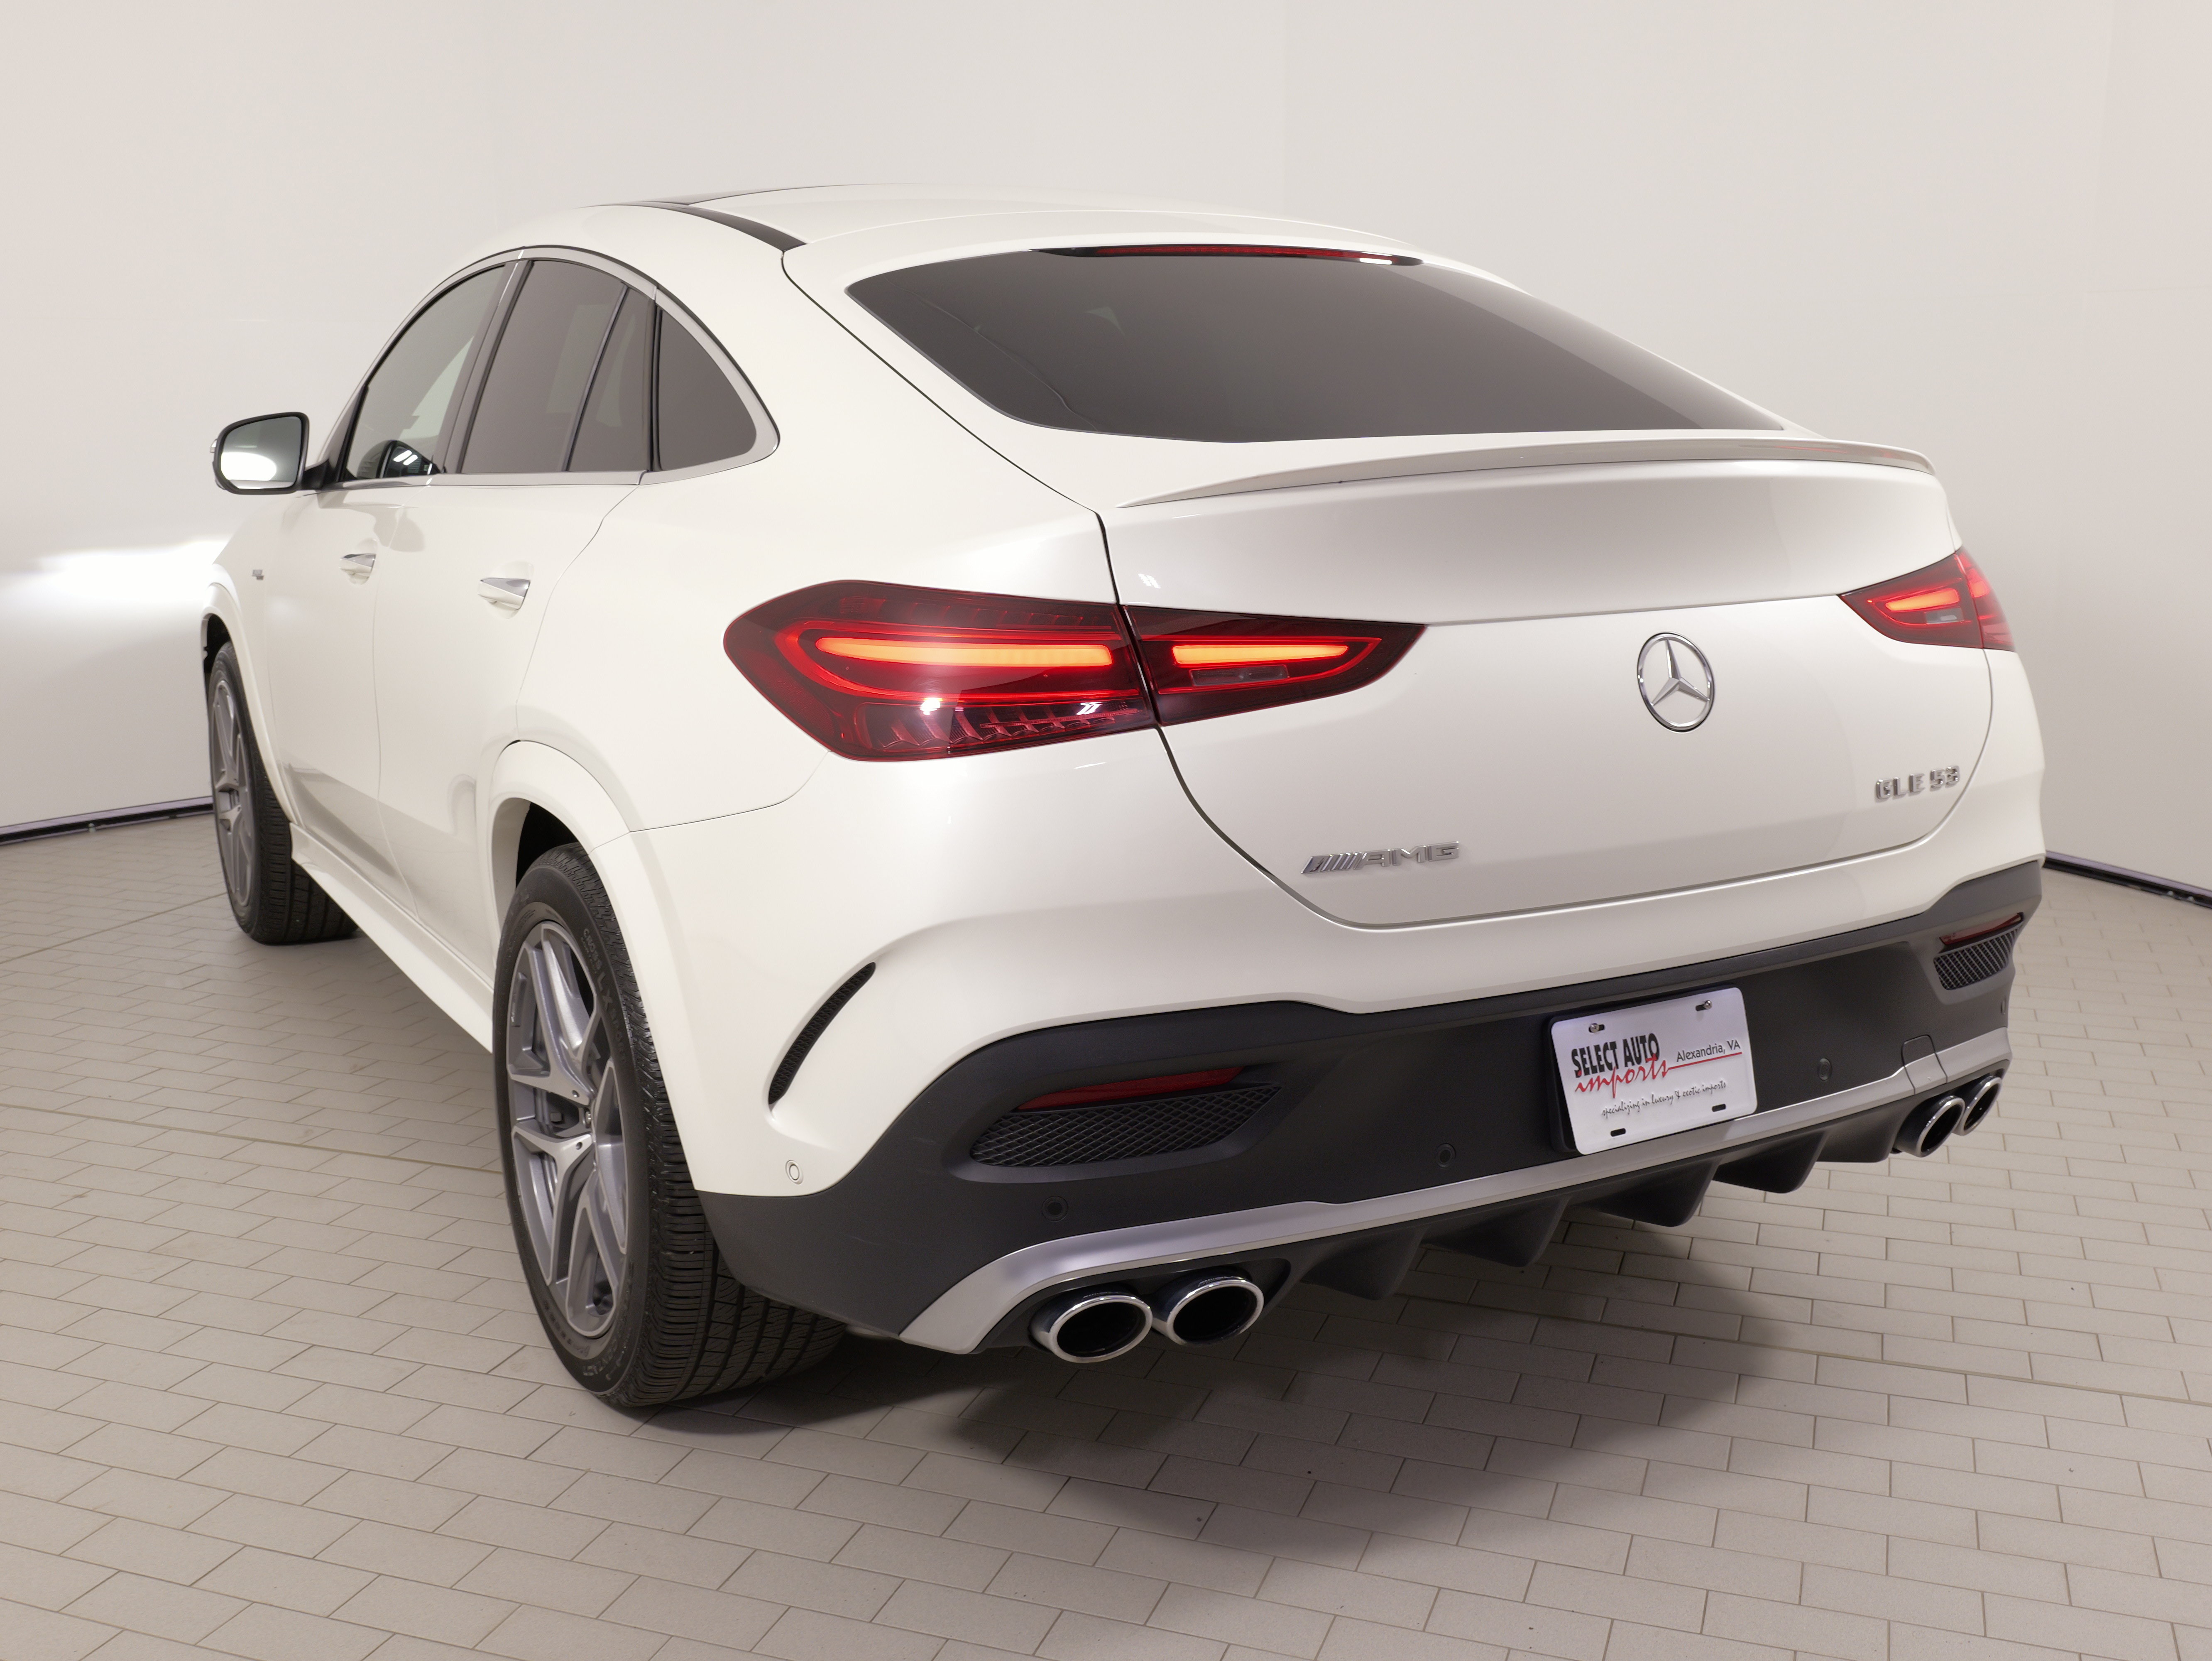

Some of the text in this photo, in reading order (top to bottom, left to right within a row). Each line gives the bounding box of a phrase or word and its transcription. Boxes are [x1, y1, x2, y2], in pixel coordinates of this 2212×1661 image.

[1875, 765, 1960, 799] GLE 53
[1353, 841, 1459, 870] AMG
[1571, 1033, 1660, 1078] SELECT AUTO
[1676, 1040, 1741, 1062] Alexandria, VA
[1575, 1053, 1669, 1098] imports
[1602, 1100, 1641, 1119] specializing
[1652, 1093, 1674, 1105] luxury
[1675, 1090, 1681, 1100] &
[1683, 1086, 1701, 1097] exotic
[1702, 1080, 1726, 1095] imports
